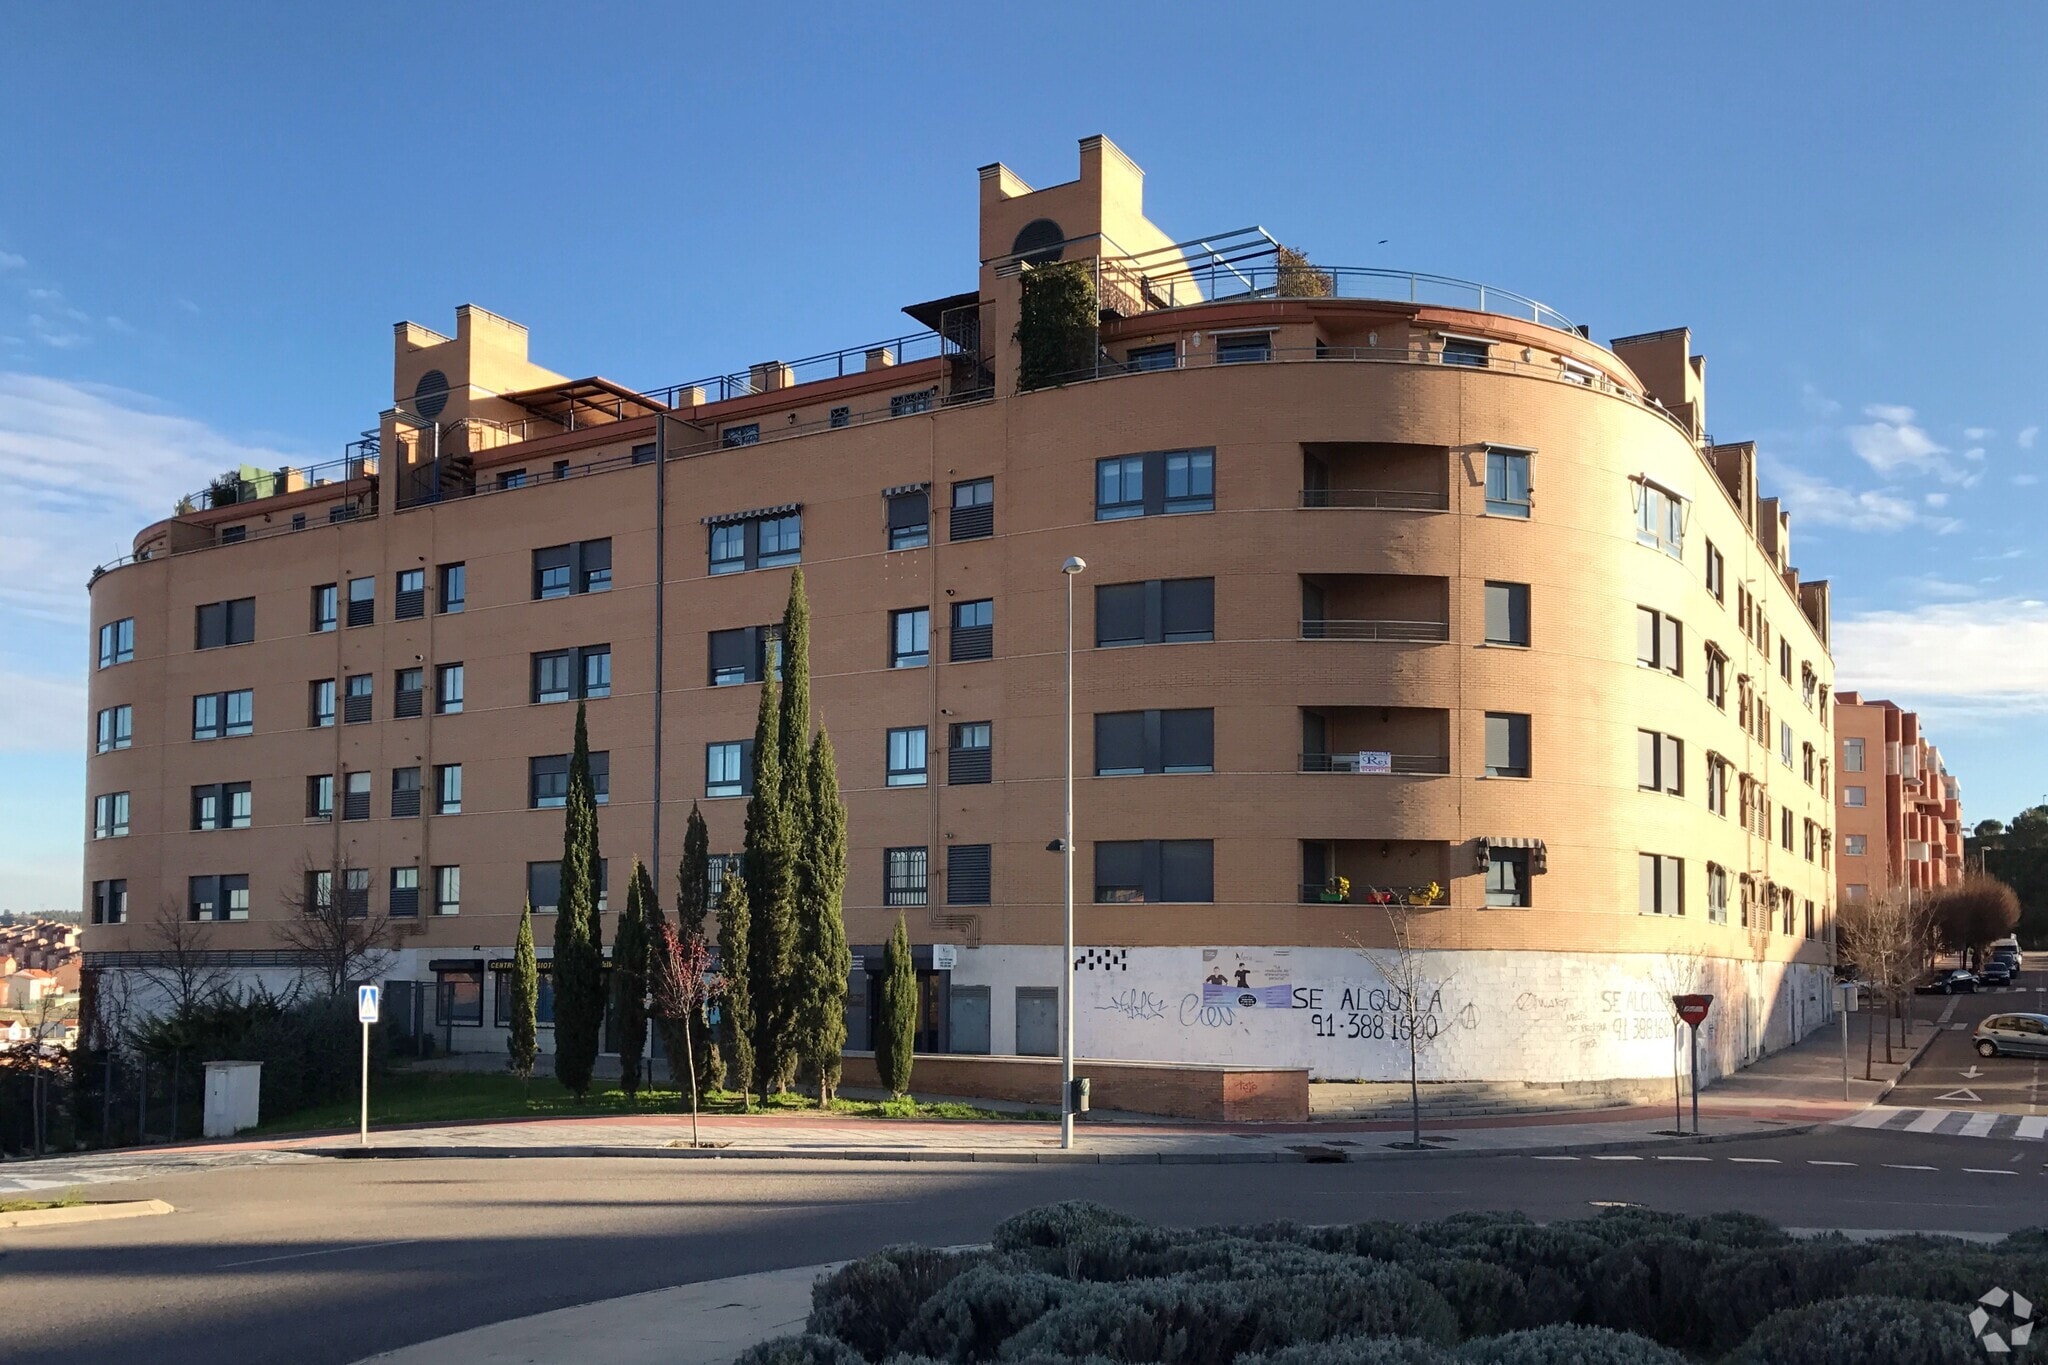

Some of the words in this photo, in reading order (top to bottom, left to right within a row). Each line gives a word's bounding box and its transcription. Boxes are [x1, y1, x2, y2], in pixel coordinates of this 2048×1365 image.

[1291, 988, 1324, 1010] SE
[1341, 988, 1443, 1013] ALQUILA
[1601, 990, 1621, 1012] SE
